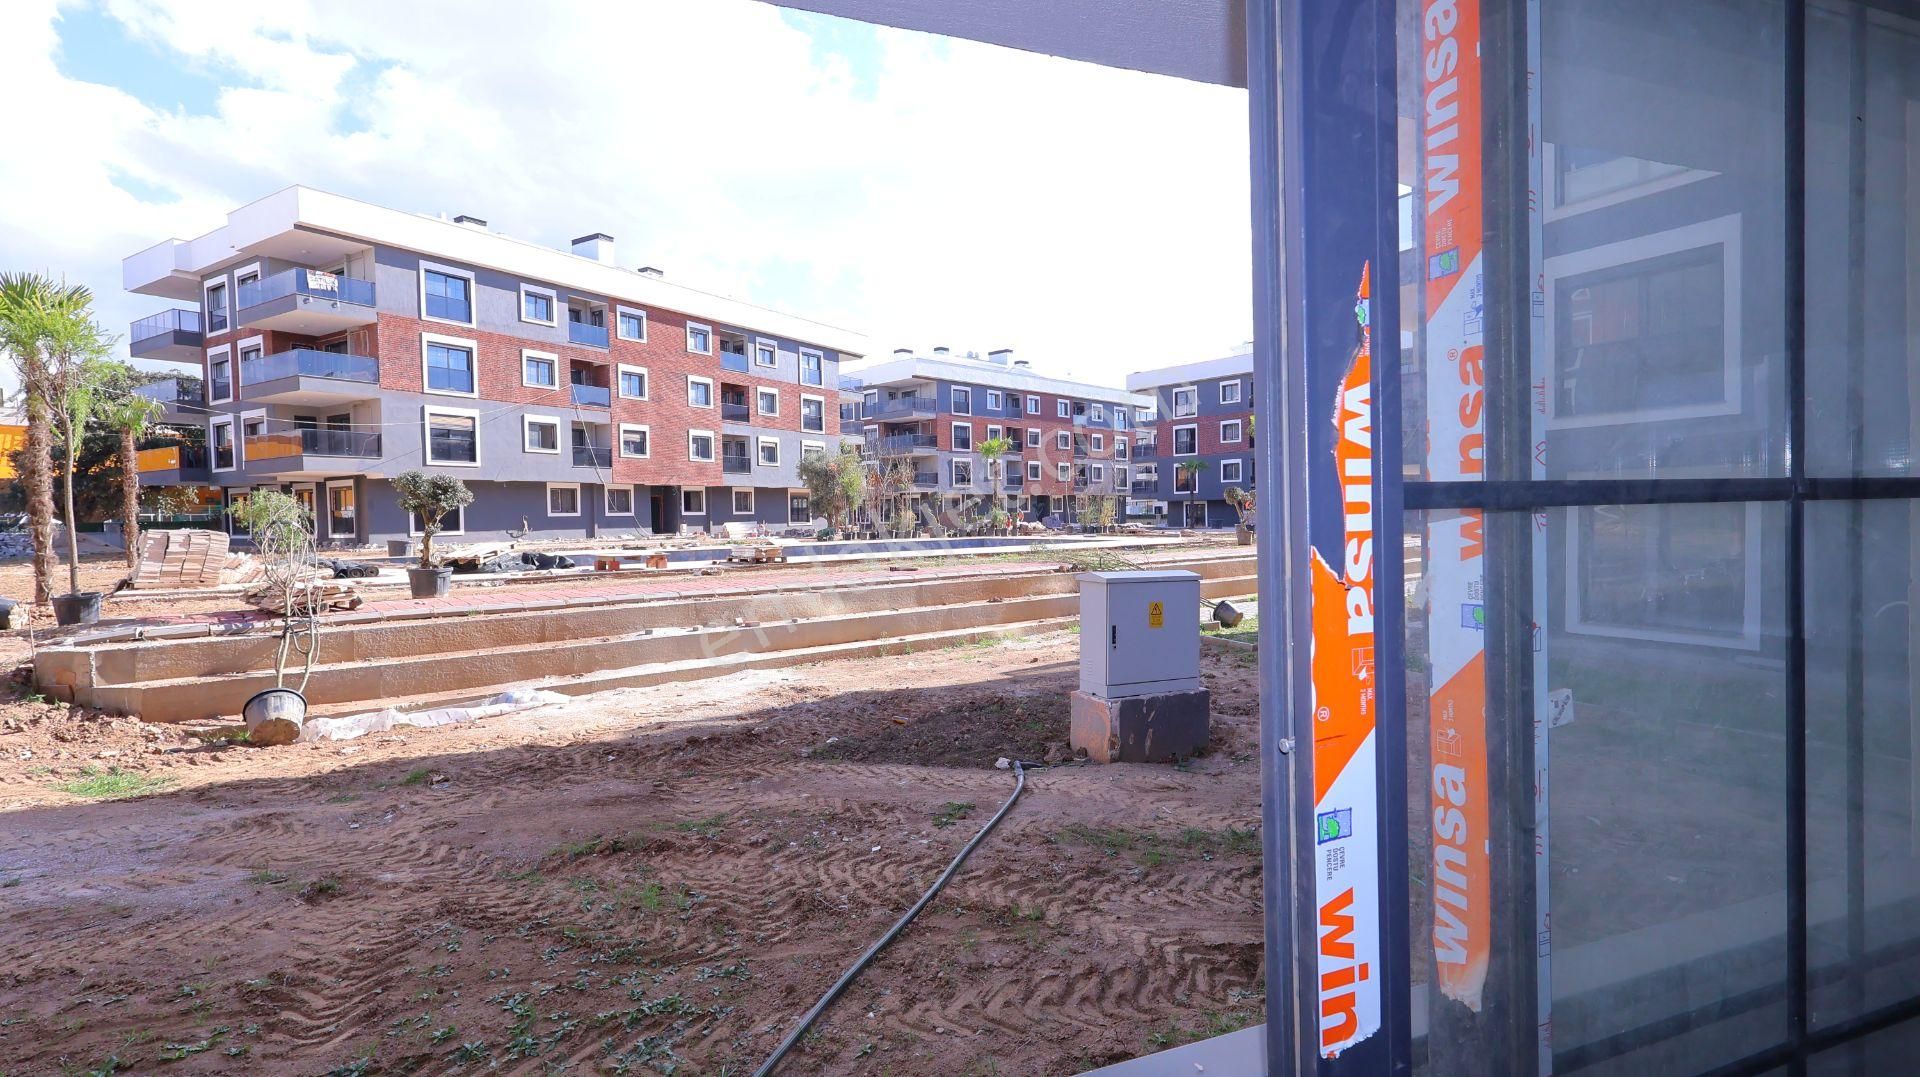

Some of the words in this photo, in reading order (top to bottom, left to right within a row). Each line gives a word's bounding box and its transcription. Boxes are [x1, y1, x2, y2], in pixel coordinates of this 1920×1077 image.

[1425, 0, 1459, 216] winsa
[1344, 384, 1374, 637] winsa
[1433, 762, 1468, 965] winsa
